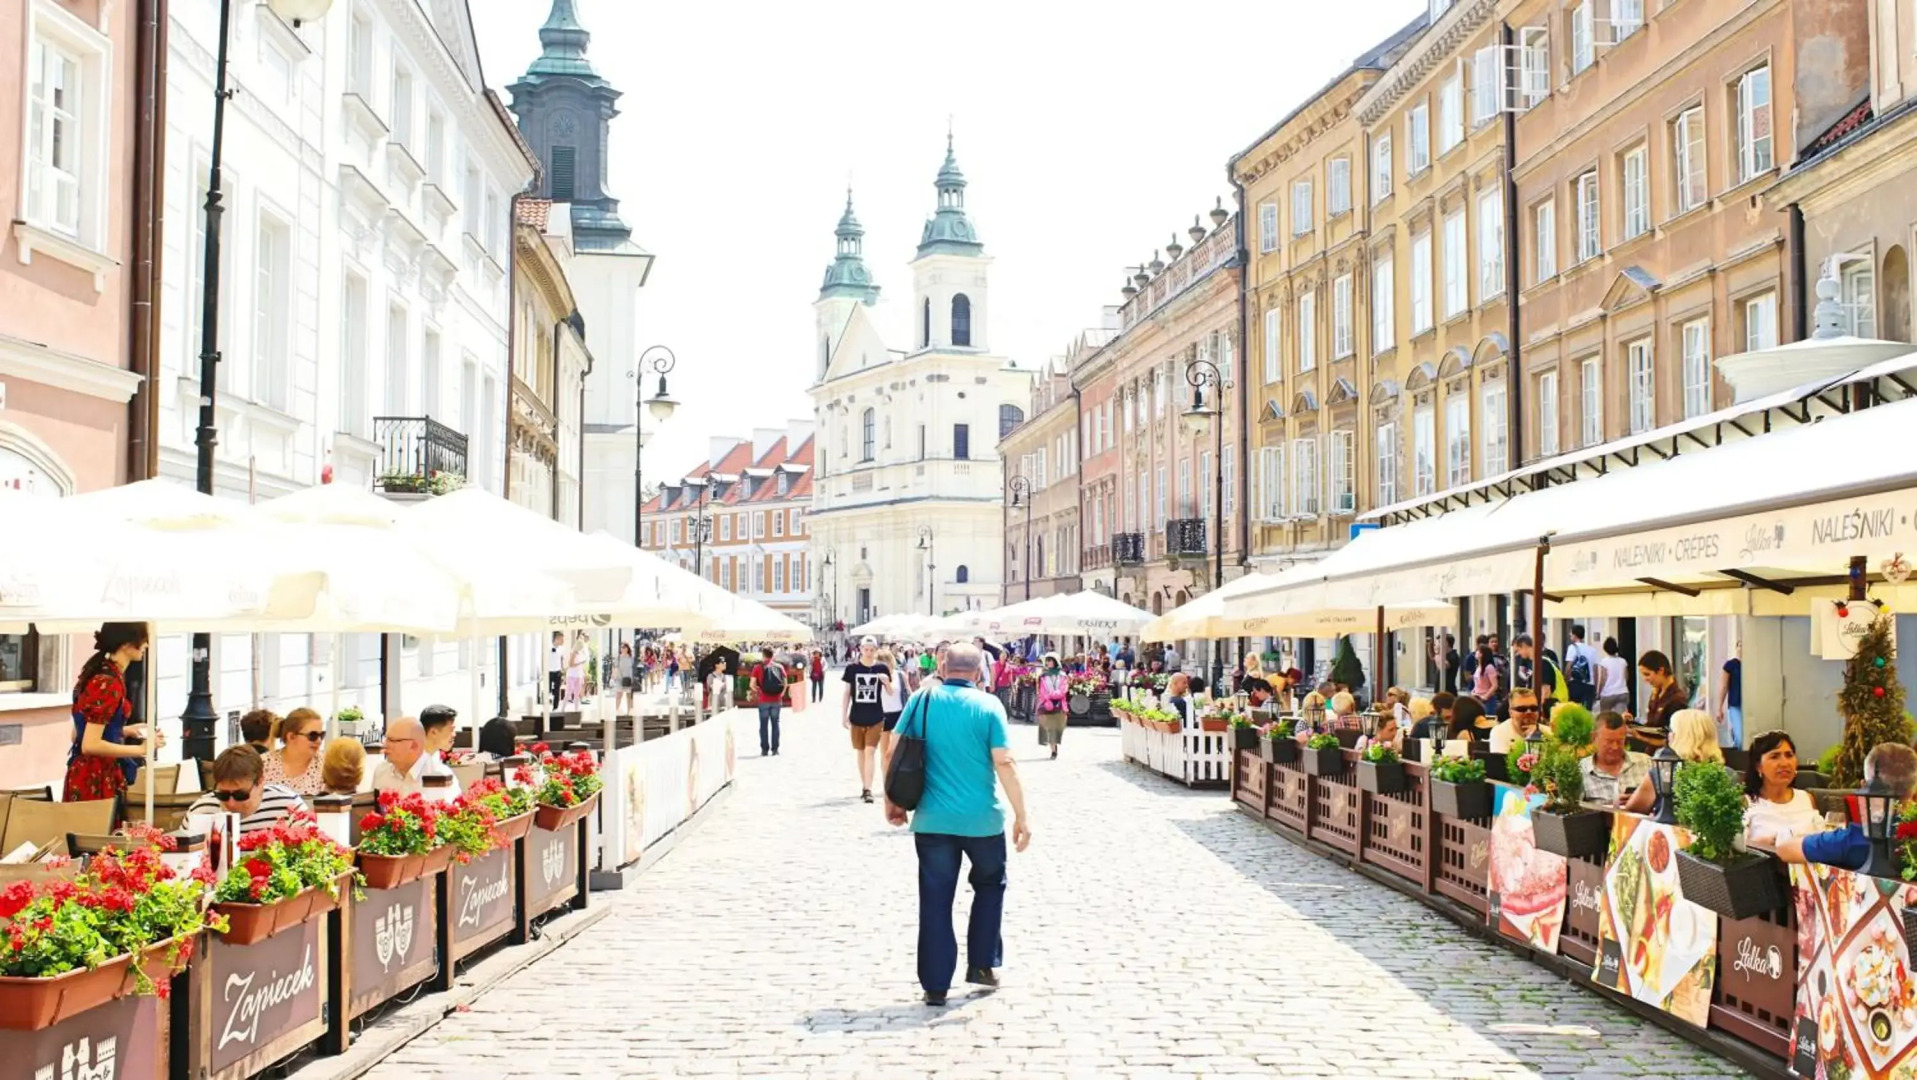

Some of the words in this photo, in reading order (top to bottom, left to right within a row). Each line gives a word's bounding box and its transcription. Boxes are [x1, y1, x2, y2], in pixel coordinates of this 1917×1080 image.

[1812, 508, 1894, 545] NALEŚNIKI
[458, 862, 509, 928] Zapiecek
[1733, 936, 1768, 982] Lalka
[218, 943, 314, 1050] Zapiecek
